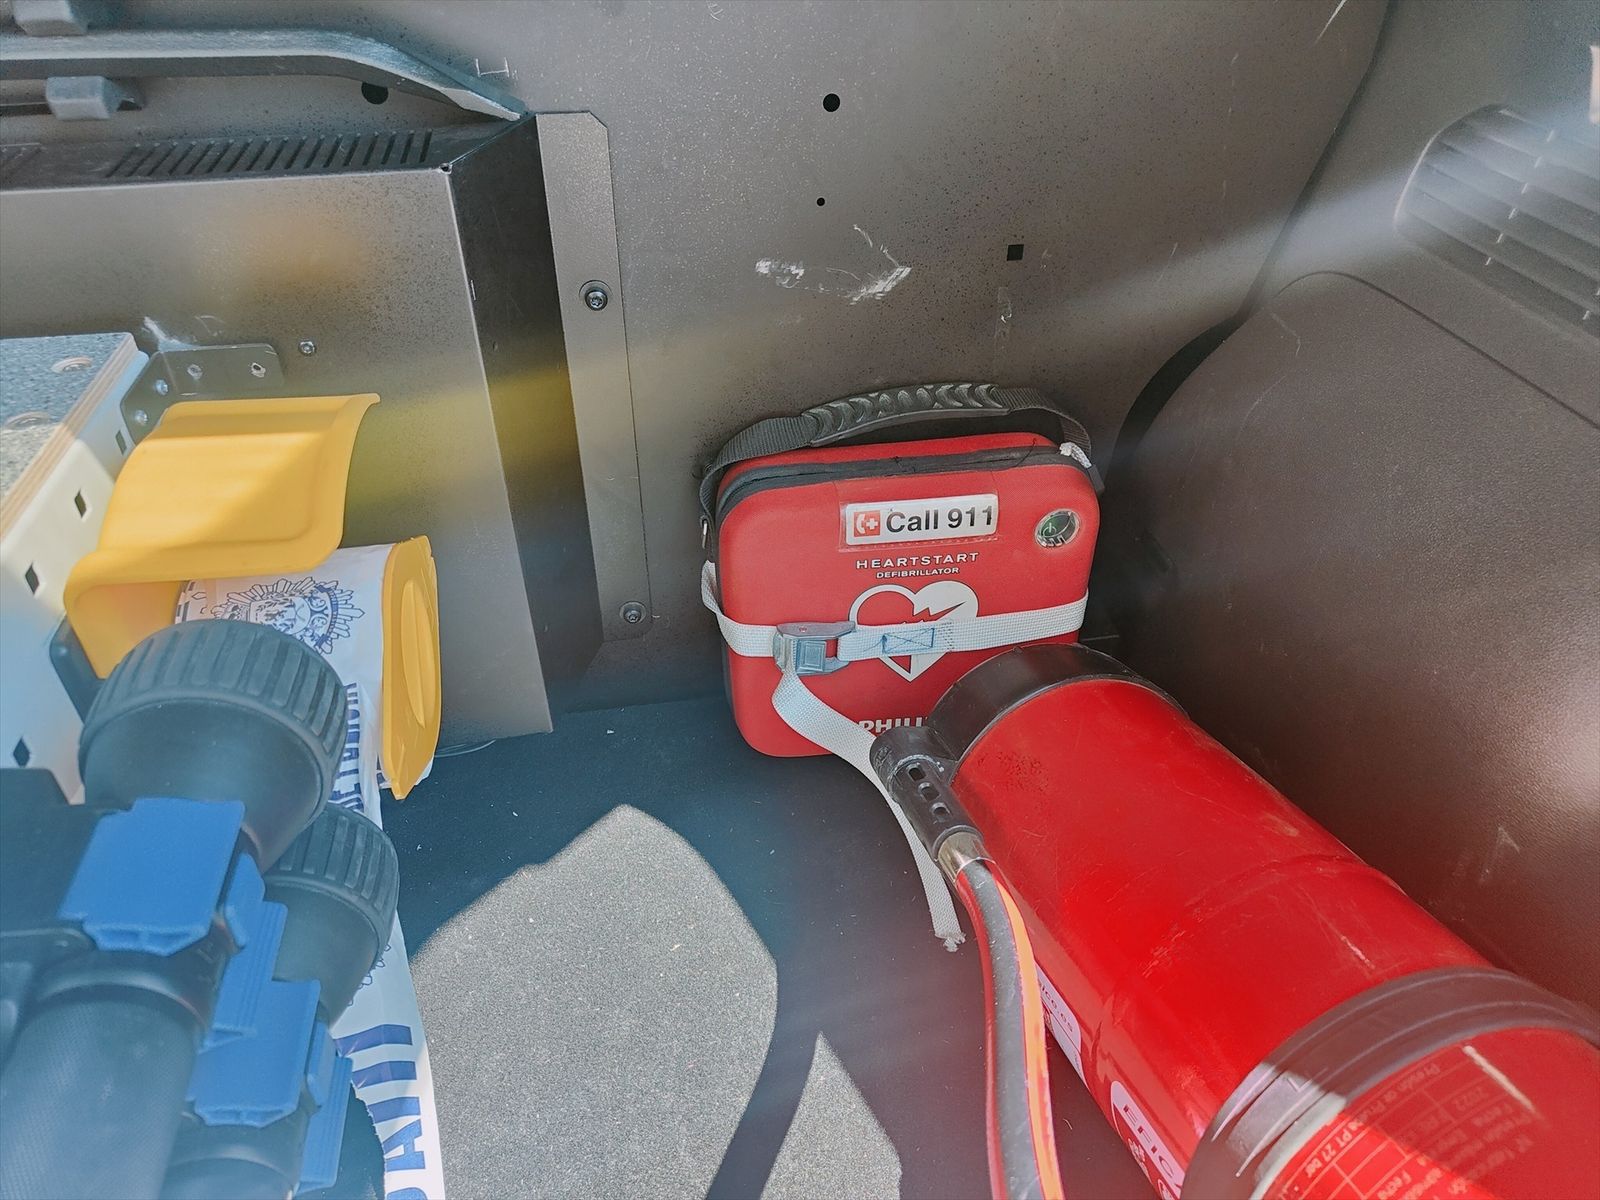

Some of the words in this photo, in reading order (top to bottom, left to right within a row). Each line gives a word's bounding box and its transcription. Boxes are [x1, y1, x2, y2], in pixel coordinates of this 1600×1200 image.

[886, 509, 939, 533] Call
[948, 505, 993, 528] 911
[856, 552, 979, 569] HEARTSTART
[876, 567, 960, 579] DEFIBRILLATOR
